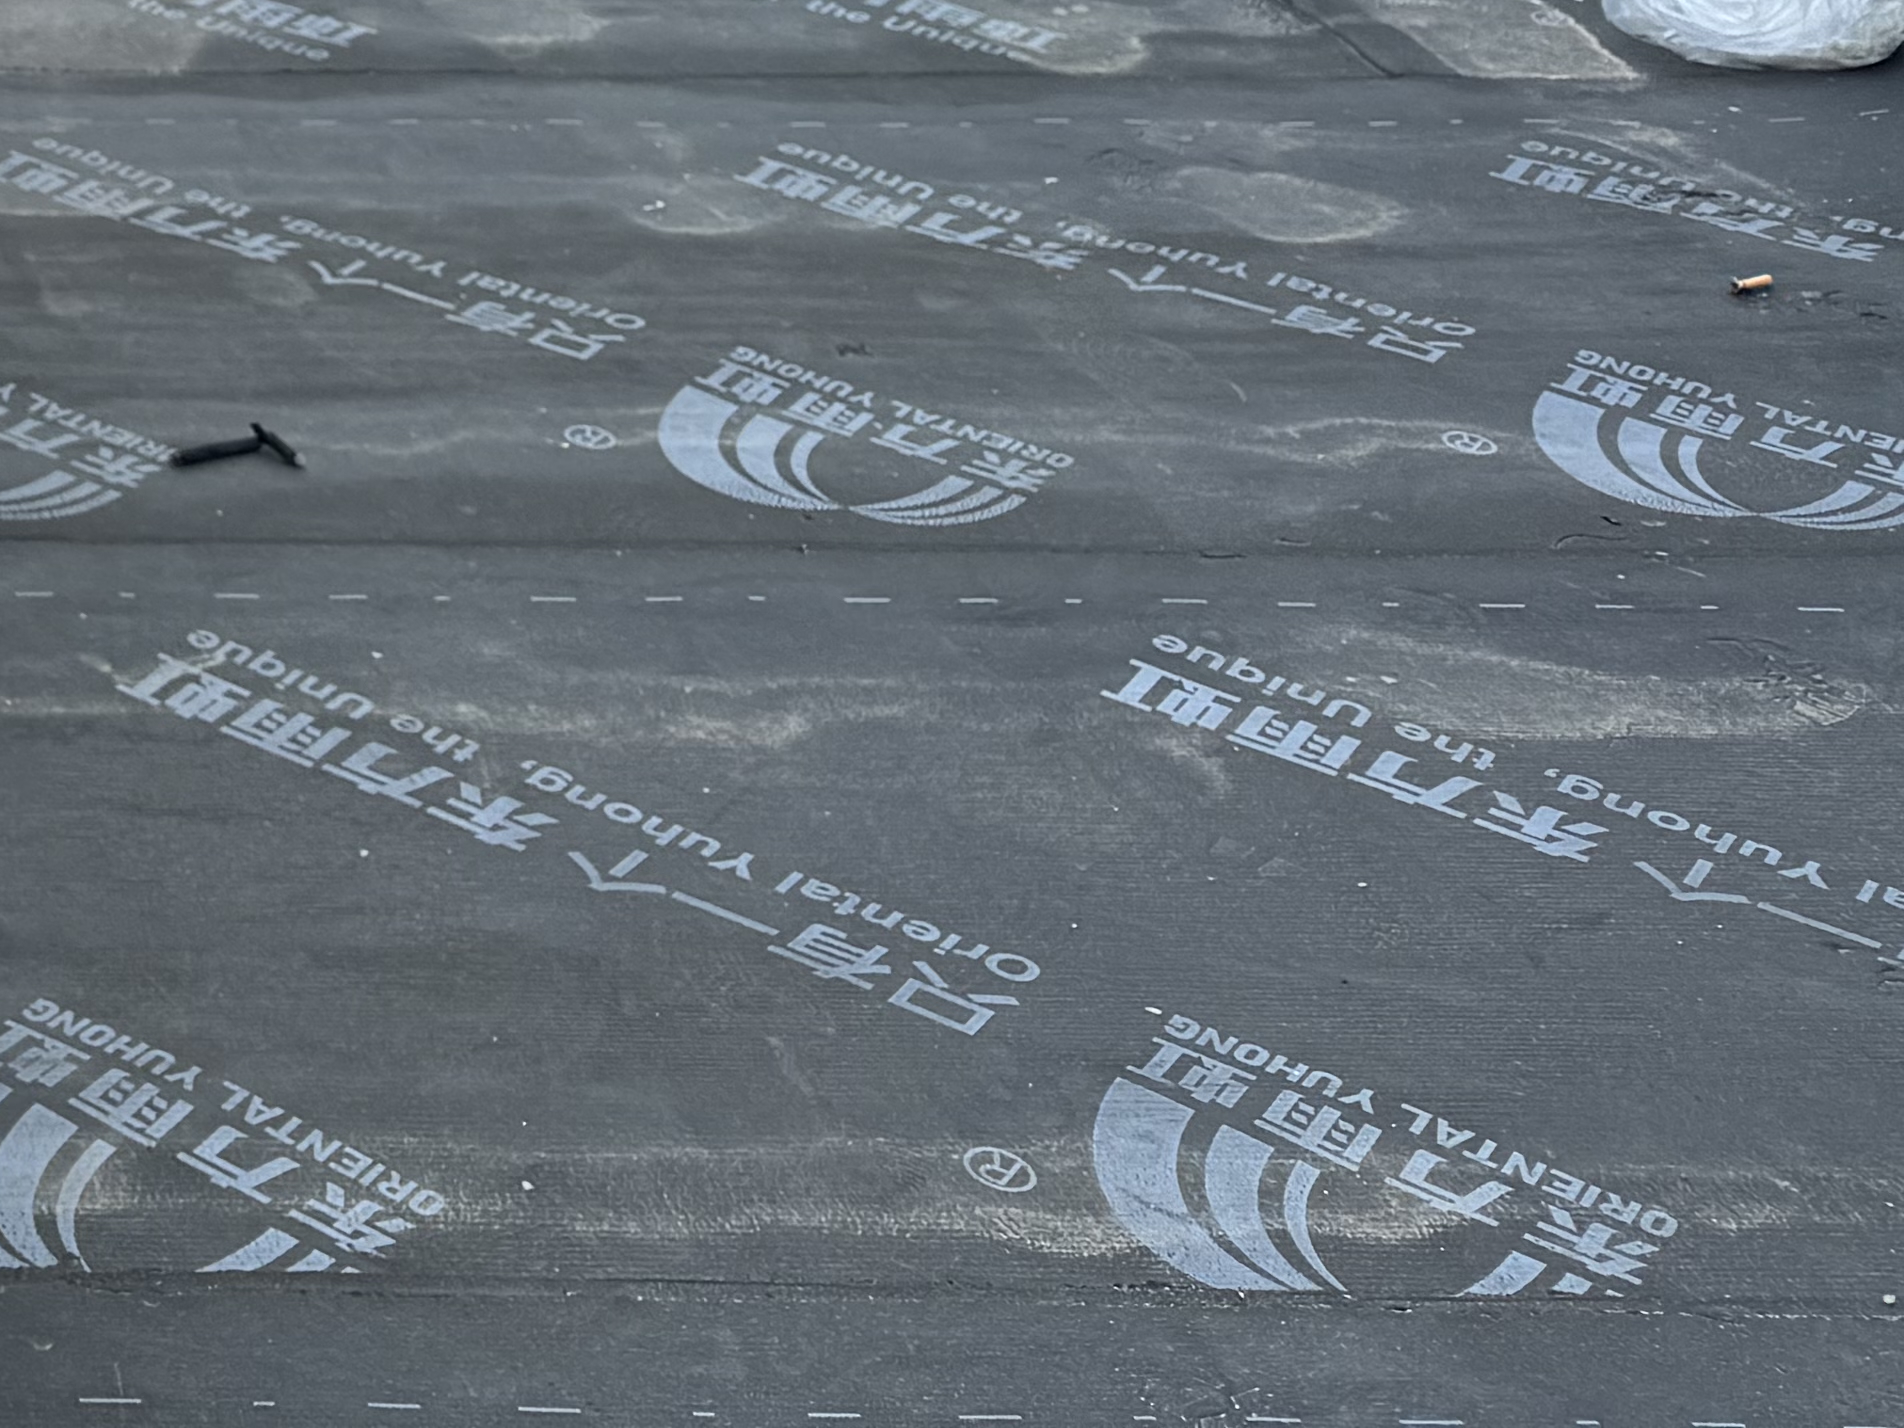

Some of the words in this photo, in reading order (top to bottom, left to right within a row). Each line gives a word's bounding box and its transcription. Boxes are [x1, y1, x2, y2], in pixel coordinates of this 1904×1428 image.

[32, 136, 176, 199] Unique
[774, 141, 936, 203] Unique
[185, 187, 254, 223] the
[947, 192, 1026, 227] the
[278, 212, 446, 281] Yuhong,
[733, 154, 1464, 365] 只有一个东方雨虹
[1055, 219, 1249, 283] Yuhong,
[458, 269, 647, 333] Oriental
[1265, 271, 1477, 338] Oriental
[728, 344, 880, 410] YUHONG
[1572, 348, 1744, 410] YUHONG
[28, 391, 179, 465] RIENTAL
[693, 359, 1059, 494] 东方雨虹
[887, 398, 1076, 470] ORIENTAL
[1755, 401, 1904, 455] IENTAL
[186, 628, 377, 716] Unique
[1150, 632, 1373, 729] Unique
[390, 712, 481, 765] the
[1394, 721, 1497, 771] the
[116, 651, 1021, 1038] 只有一个东方雨虹
[518, 756, 756, 882] Yuhong,
[1100, 657, 1904, 970] 一个东方雨虹
[1542, 766, 1831, 892] Yuhong,
[773, 869, 1042, 983] Oriental
[21, 995, 215, 1095] YUHONG
[1163, 1010, 1375, 1117] YUHONG
[218, 1079, 448, 1218] ORIENTAL
[1125, 1034, 1661, 1286] 东方雨虹
[1399, 1101, 1681, 1240] ORIENTAL
